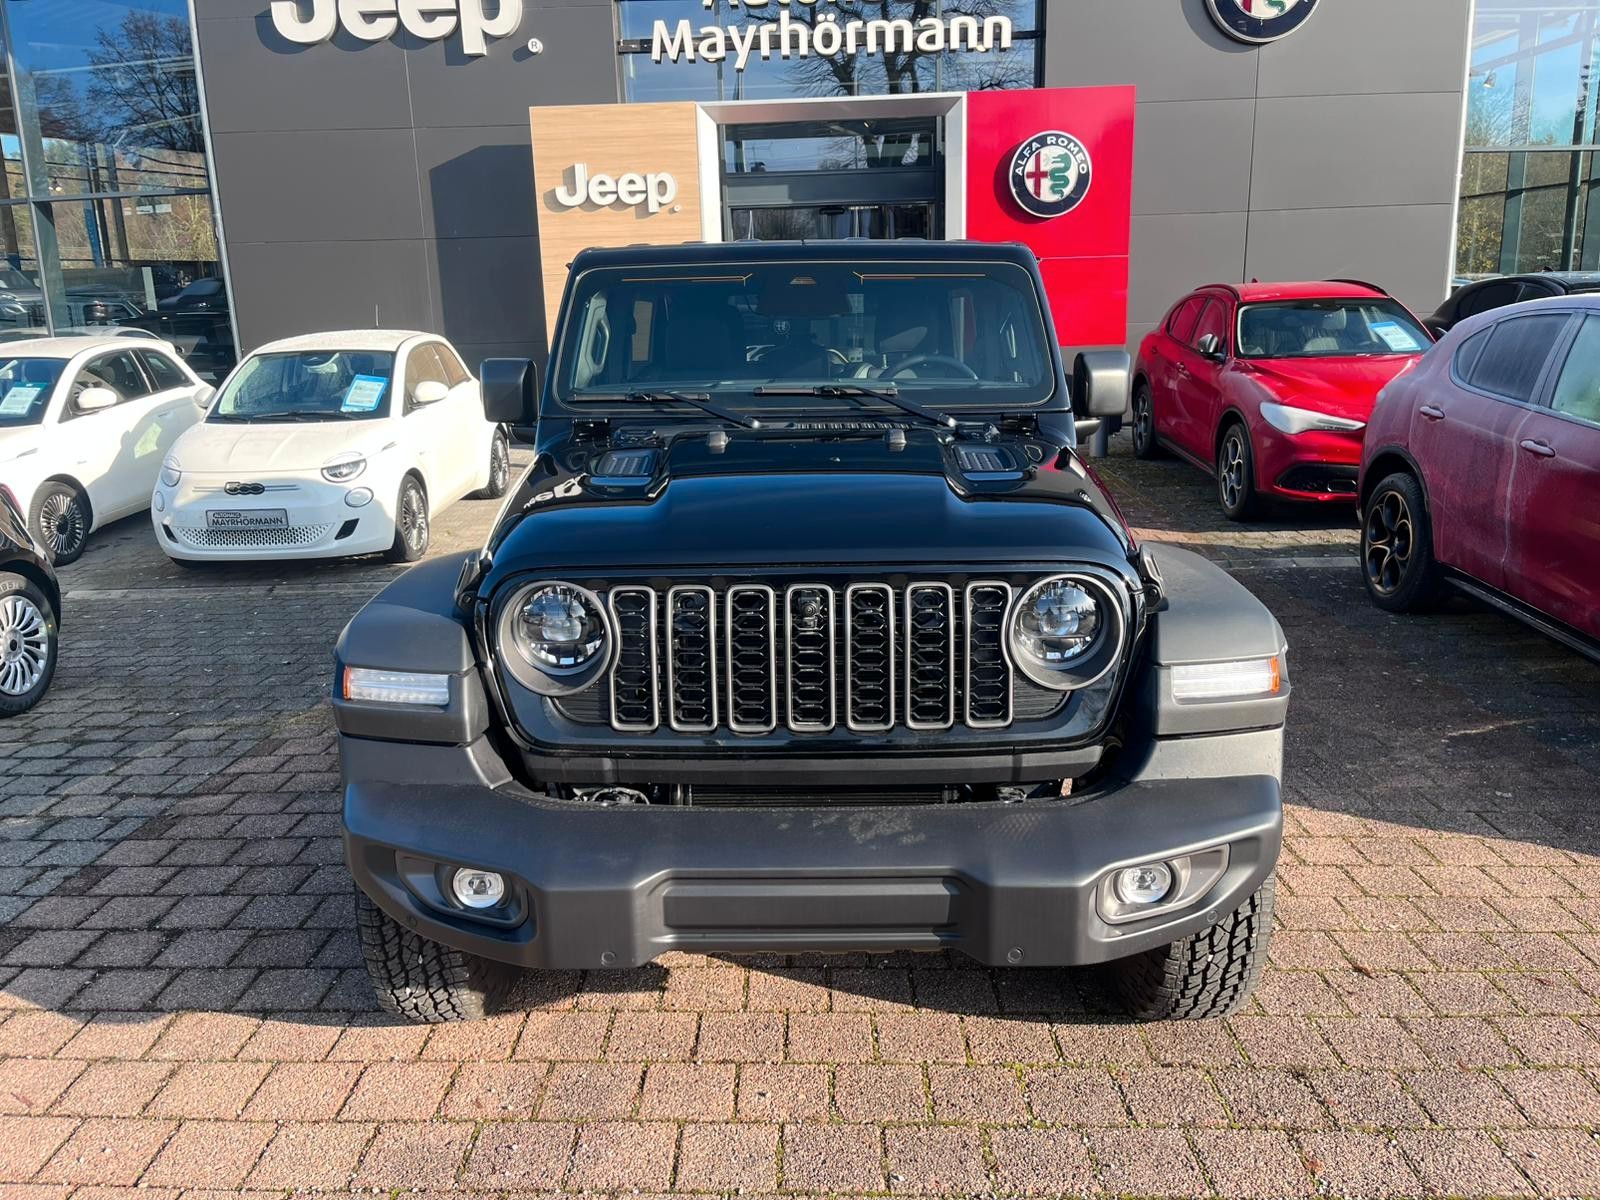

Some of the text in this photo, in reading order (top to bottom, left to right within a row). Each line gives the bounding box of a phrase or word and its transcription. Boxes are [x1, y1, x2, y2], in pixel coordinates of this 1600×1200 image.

[651, 10, 1013, 71] Mayrhörmann
[1015, 136, 1088, 176] ALFA ROMEO
[555, 163, 677, 213] Jeep
